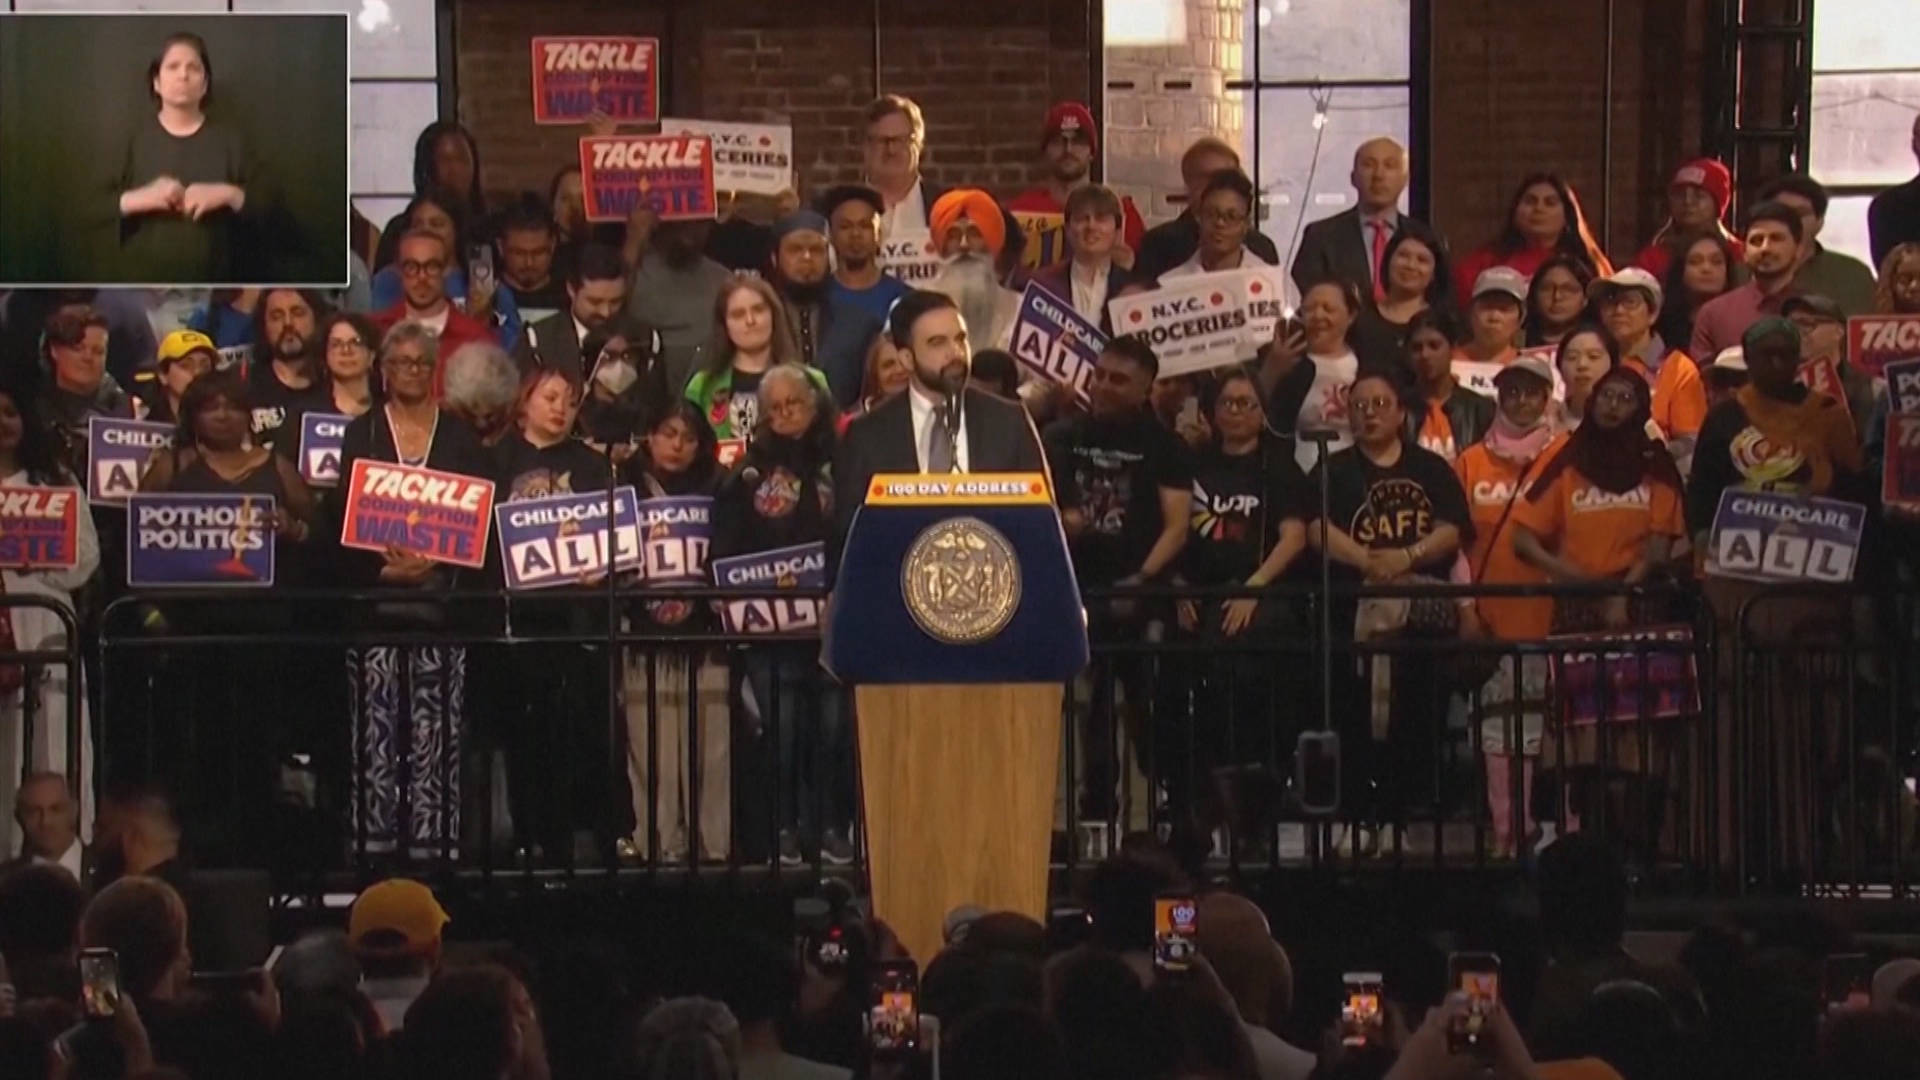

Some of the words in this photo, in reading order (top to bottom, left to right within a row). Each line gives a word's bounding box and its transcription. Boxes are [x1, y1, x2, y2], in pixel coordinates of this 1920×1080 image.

[544, 43, 653, 71] TACKLE
[592, 139, 706, 170] TACKLE
[714, 149, 789, 168] CERIES
[1151, 297, 1206, 319] N.Y.C.
[1133, 308, 1247, 347] ROCERIES
[362, 466, 487, 512] TACKLE
[888, 482, 915, 495] 100
[918, 482, 950, 495] DAY
[954, 481, 1029, 495] ADDRESS
[138, 505, 262, 528] POTHOLE
[1358, 509, 1430, 541] SAFE
[1731, 498, 1849, 530] CHILDCARE
[139, 528, 263, 550] POLITICS
[355, 512, 476, 560] WASTE
